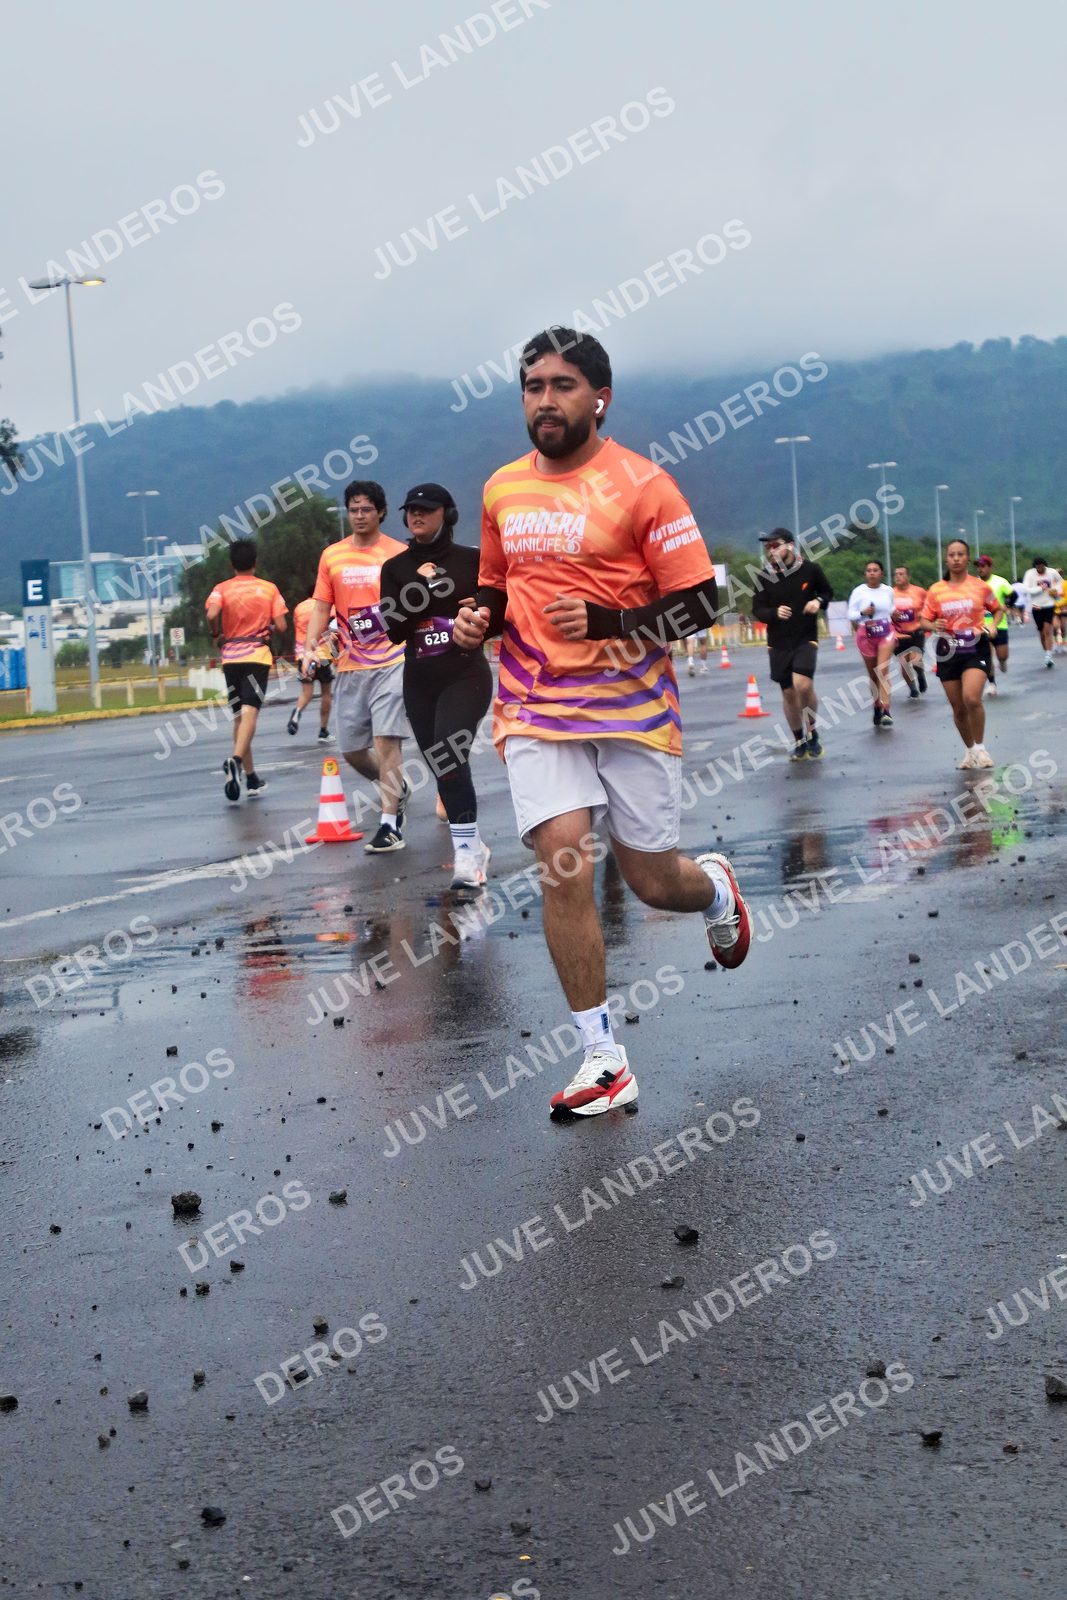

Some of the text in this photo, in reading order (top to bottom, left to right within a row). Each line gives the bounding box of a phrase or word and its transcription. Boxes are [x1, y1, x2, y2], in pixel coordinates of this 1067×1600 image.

[504, 512, 586, 537] CARRERA
[28, 579, 44, 600] E
[425, 632, 450, 646] 628
